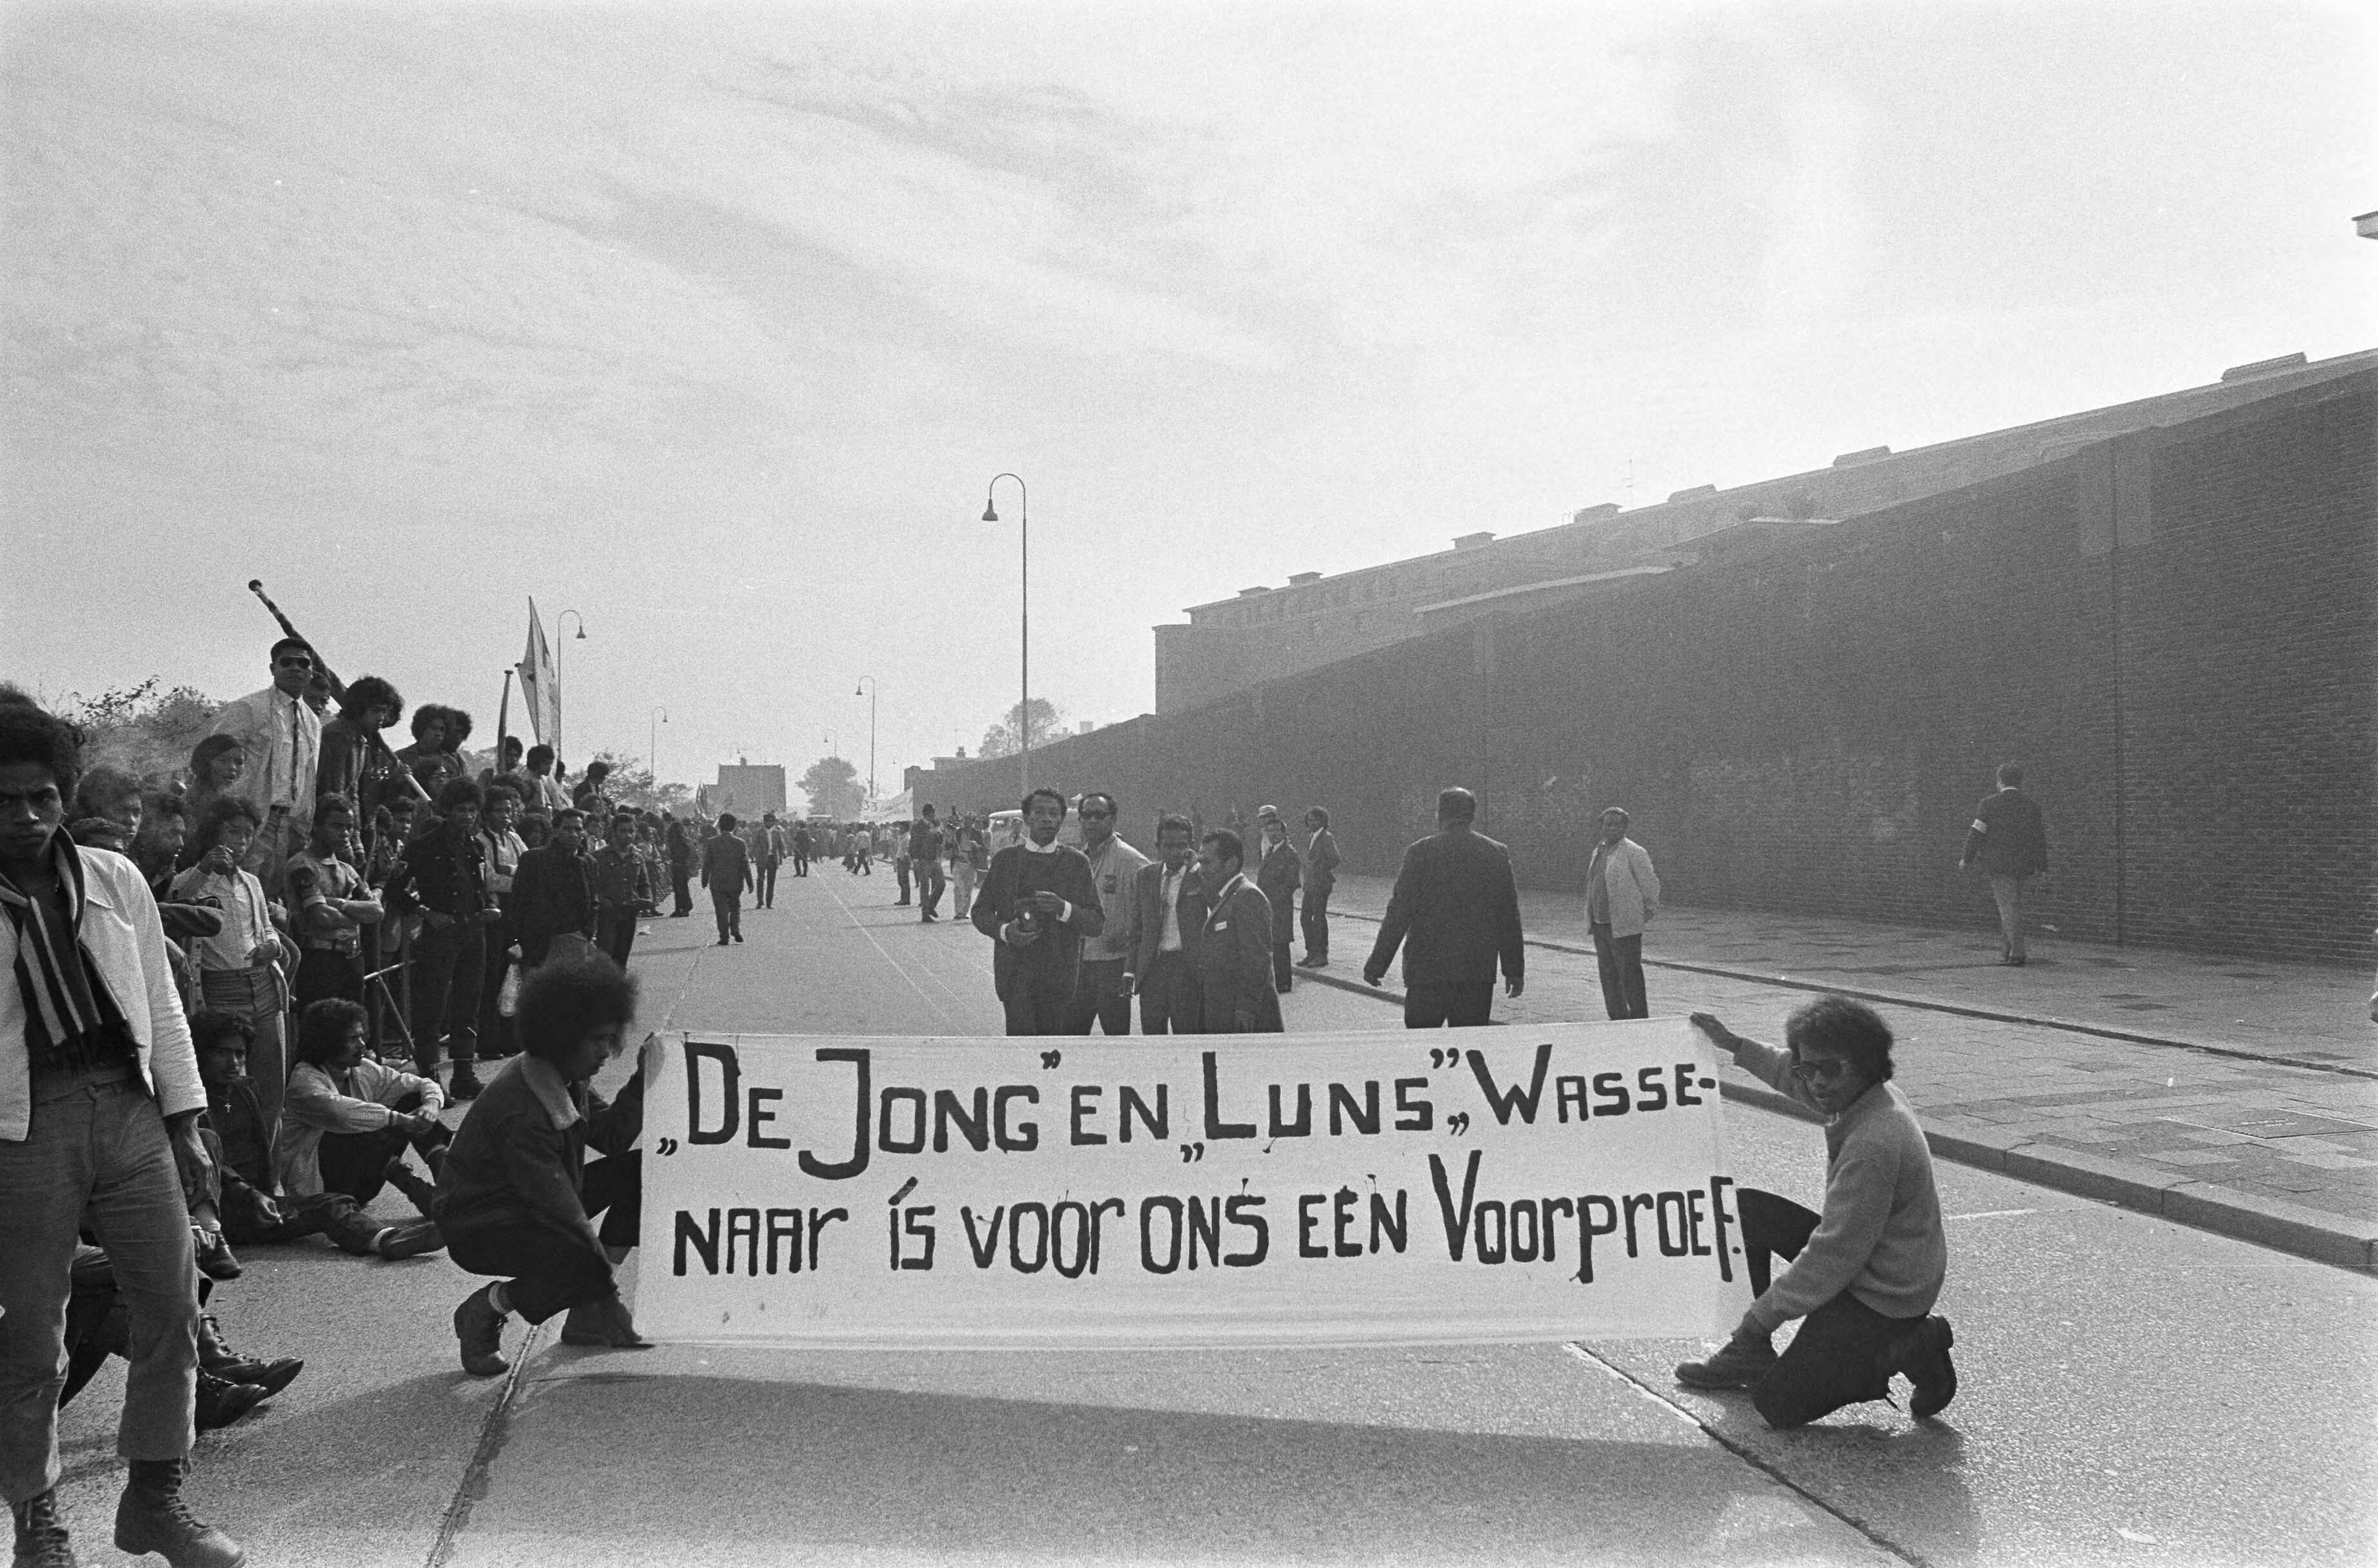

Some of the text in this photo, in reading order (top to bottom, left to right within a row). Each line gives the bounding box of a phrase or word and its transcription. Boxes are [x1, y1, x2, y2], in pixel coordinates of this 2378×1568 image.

[1070, 1084, 1169, 1146] EN
[1140, 1194, 1269, 1275] ONS
[1298, 1186, 1407, 1258] EEN
